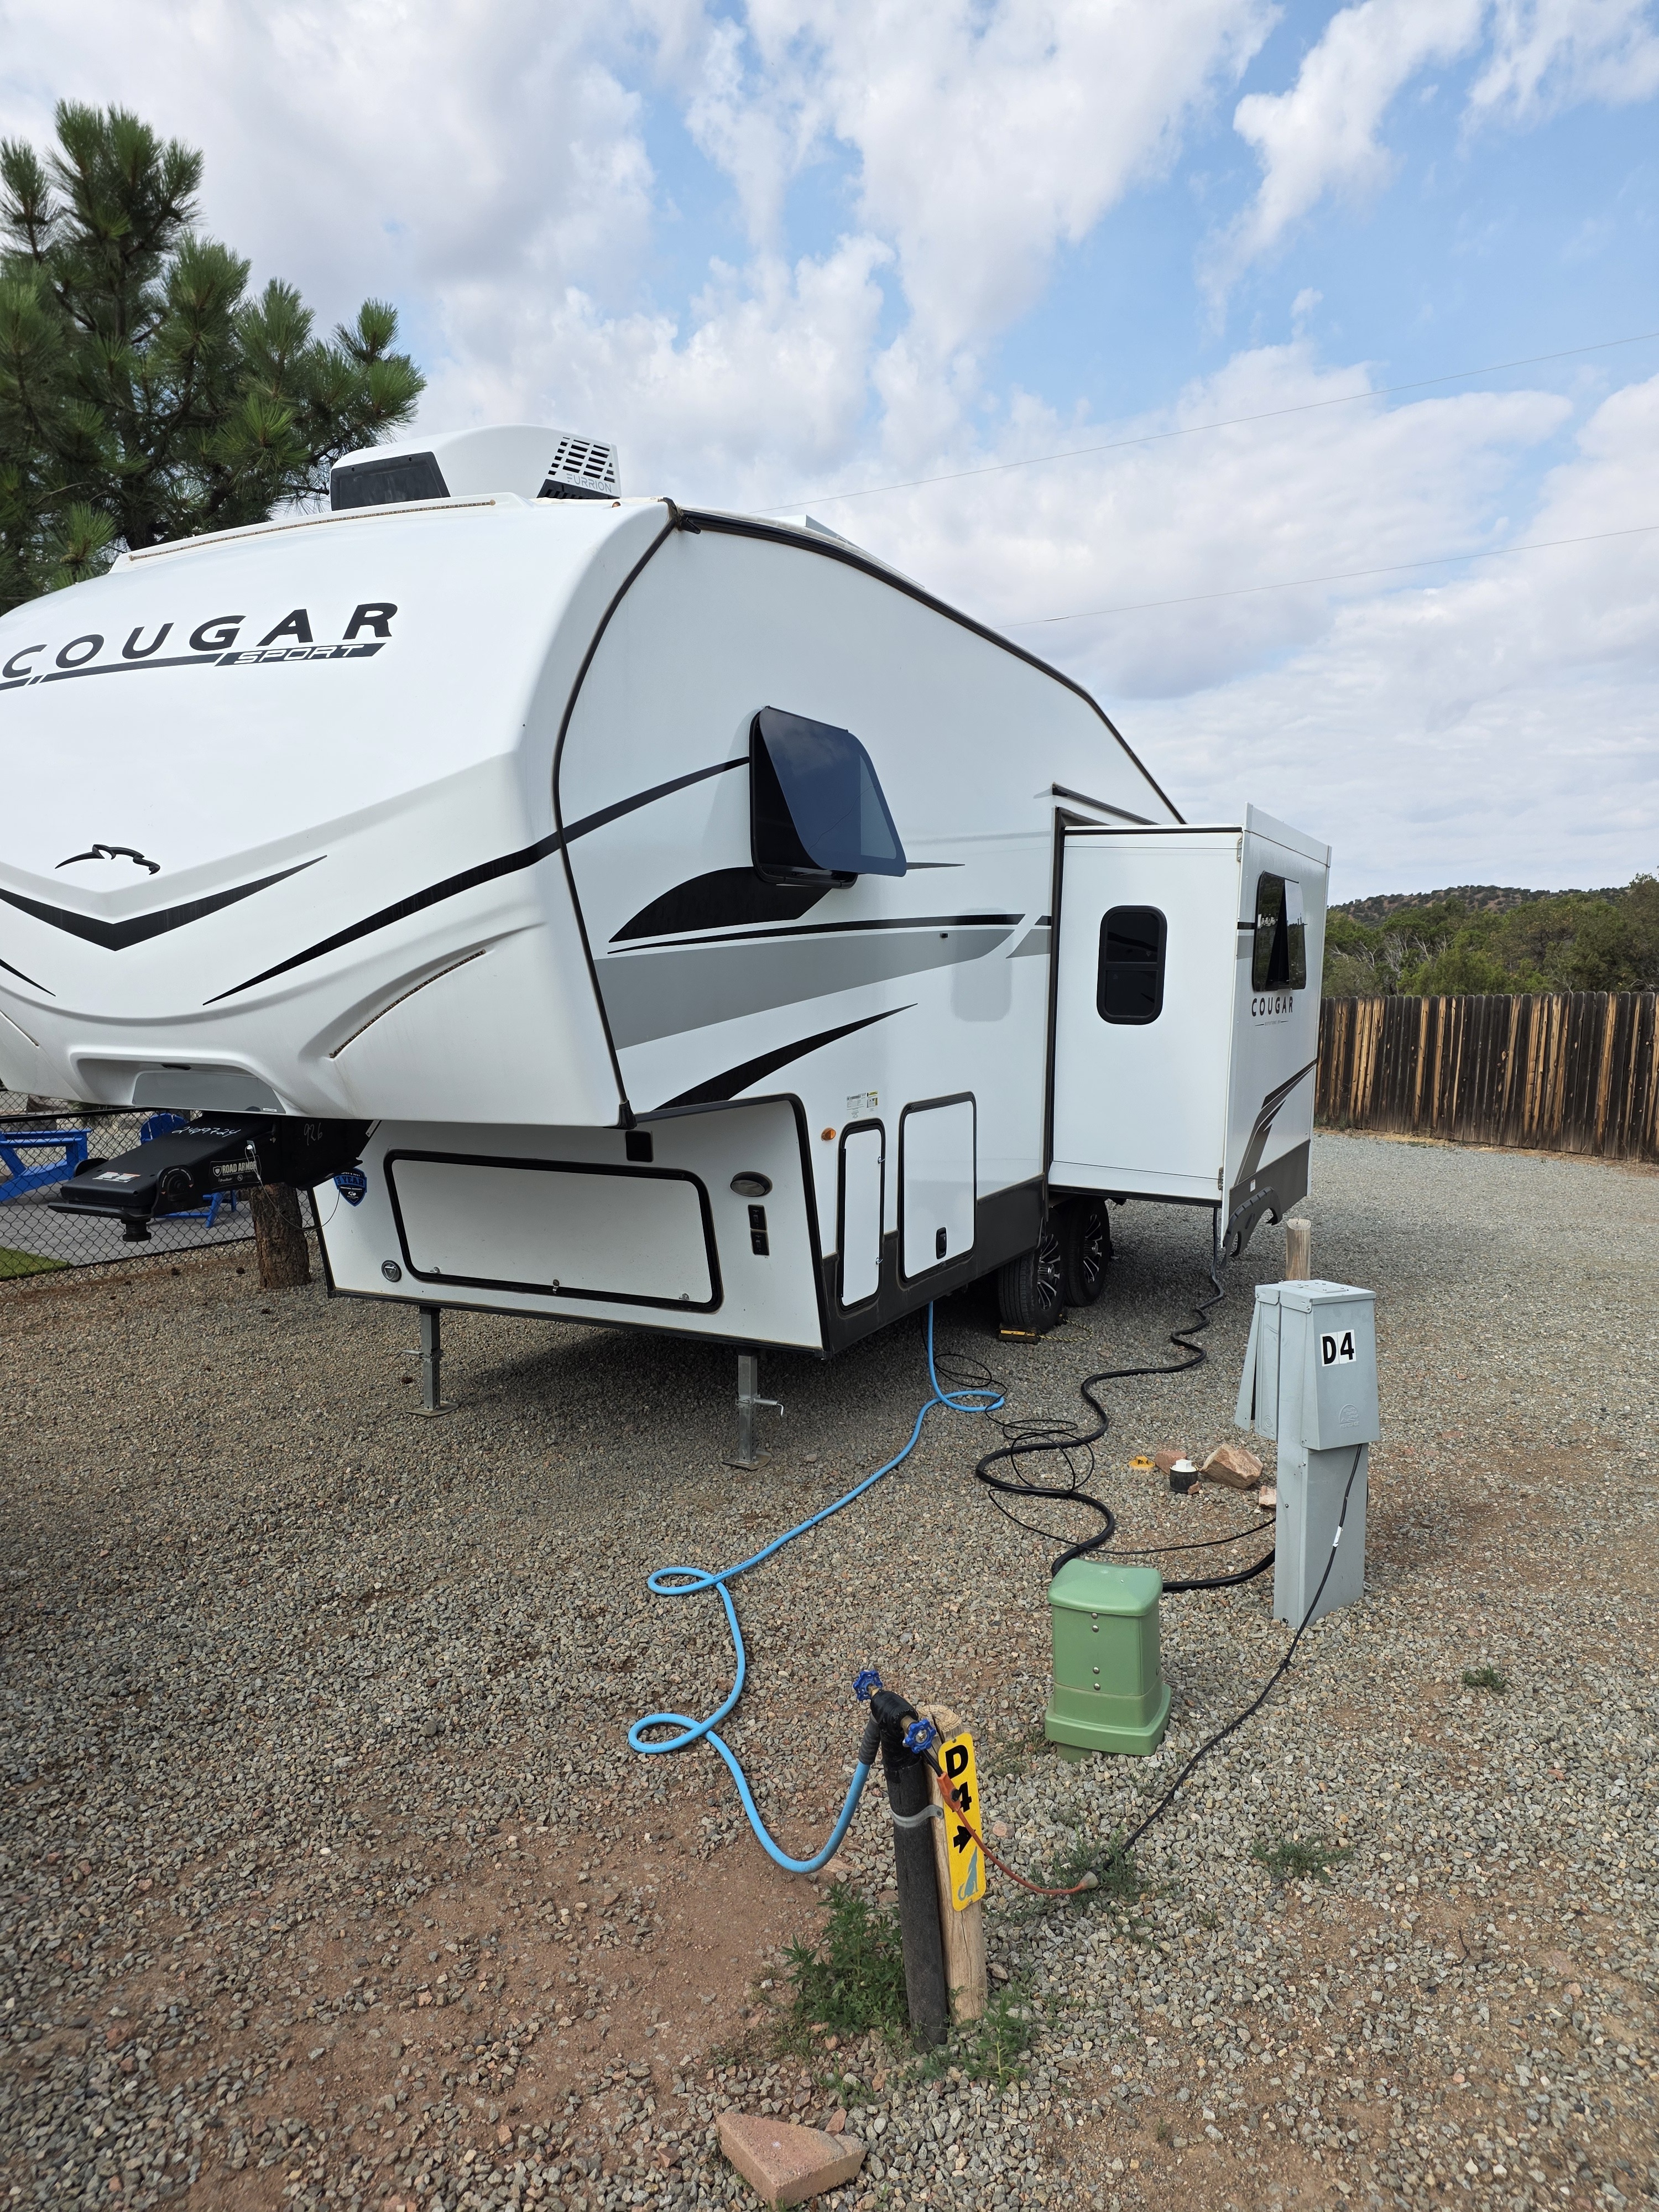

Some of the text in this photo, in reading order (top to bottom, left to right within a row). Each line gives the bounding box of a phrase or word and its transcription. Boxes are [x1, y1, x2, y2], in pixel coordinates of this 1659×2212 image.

[566, 473, 612, 493] FURRION
[2, 602, 398, 679] COUGAR
[233, 644, 364, 664] SPORT
[1251, 997, 1293, 1016] COUGAR
[222, 1163, 237, 1174] ROAD
[238, 1161, 257, 1172] ARMOR
[342, 1176, 363, 1186] YEAR
[1322, 1332, 1354, 1364] D4
